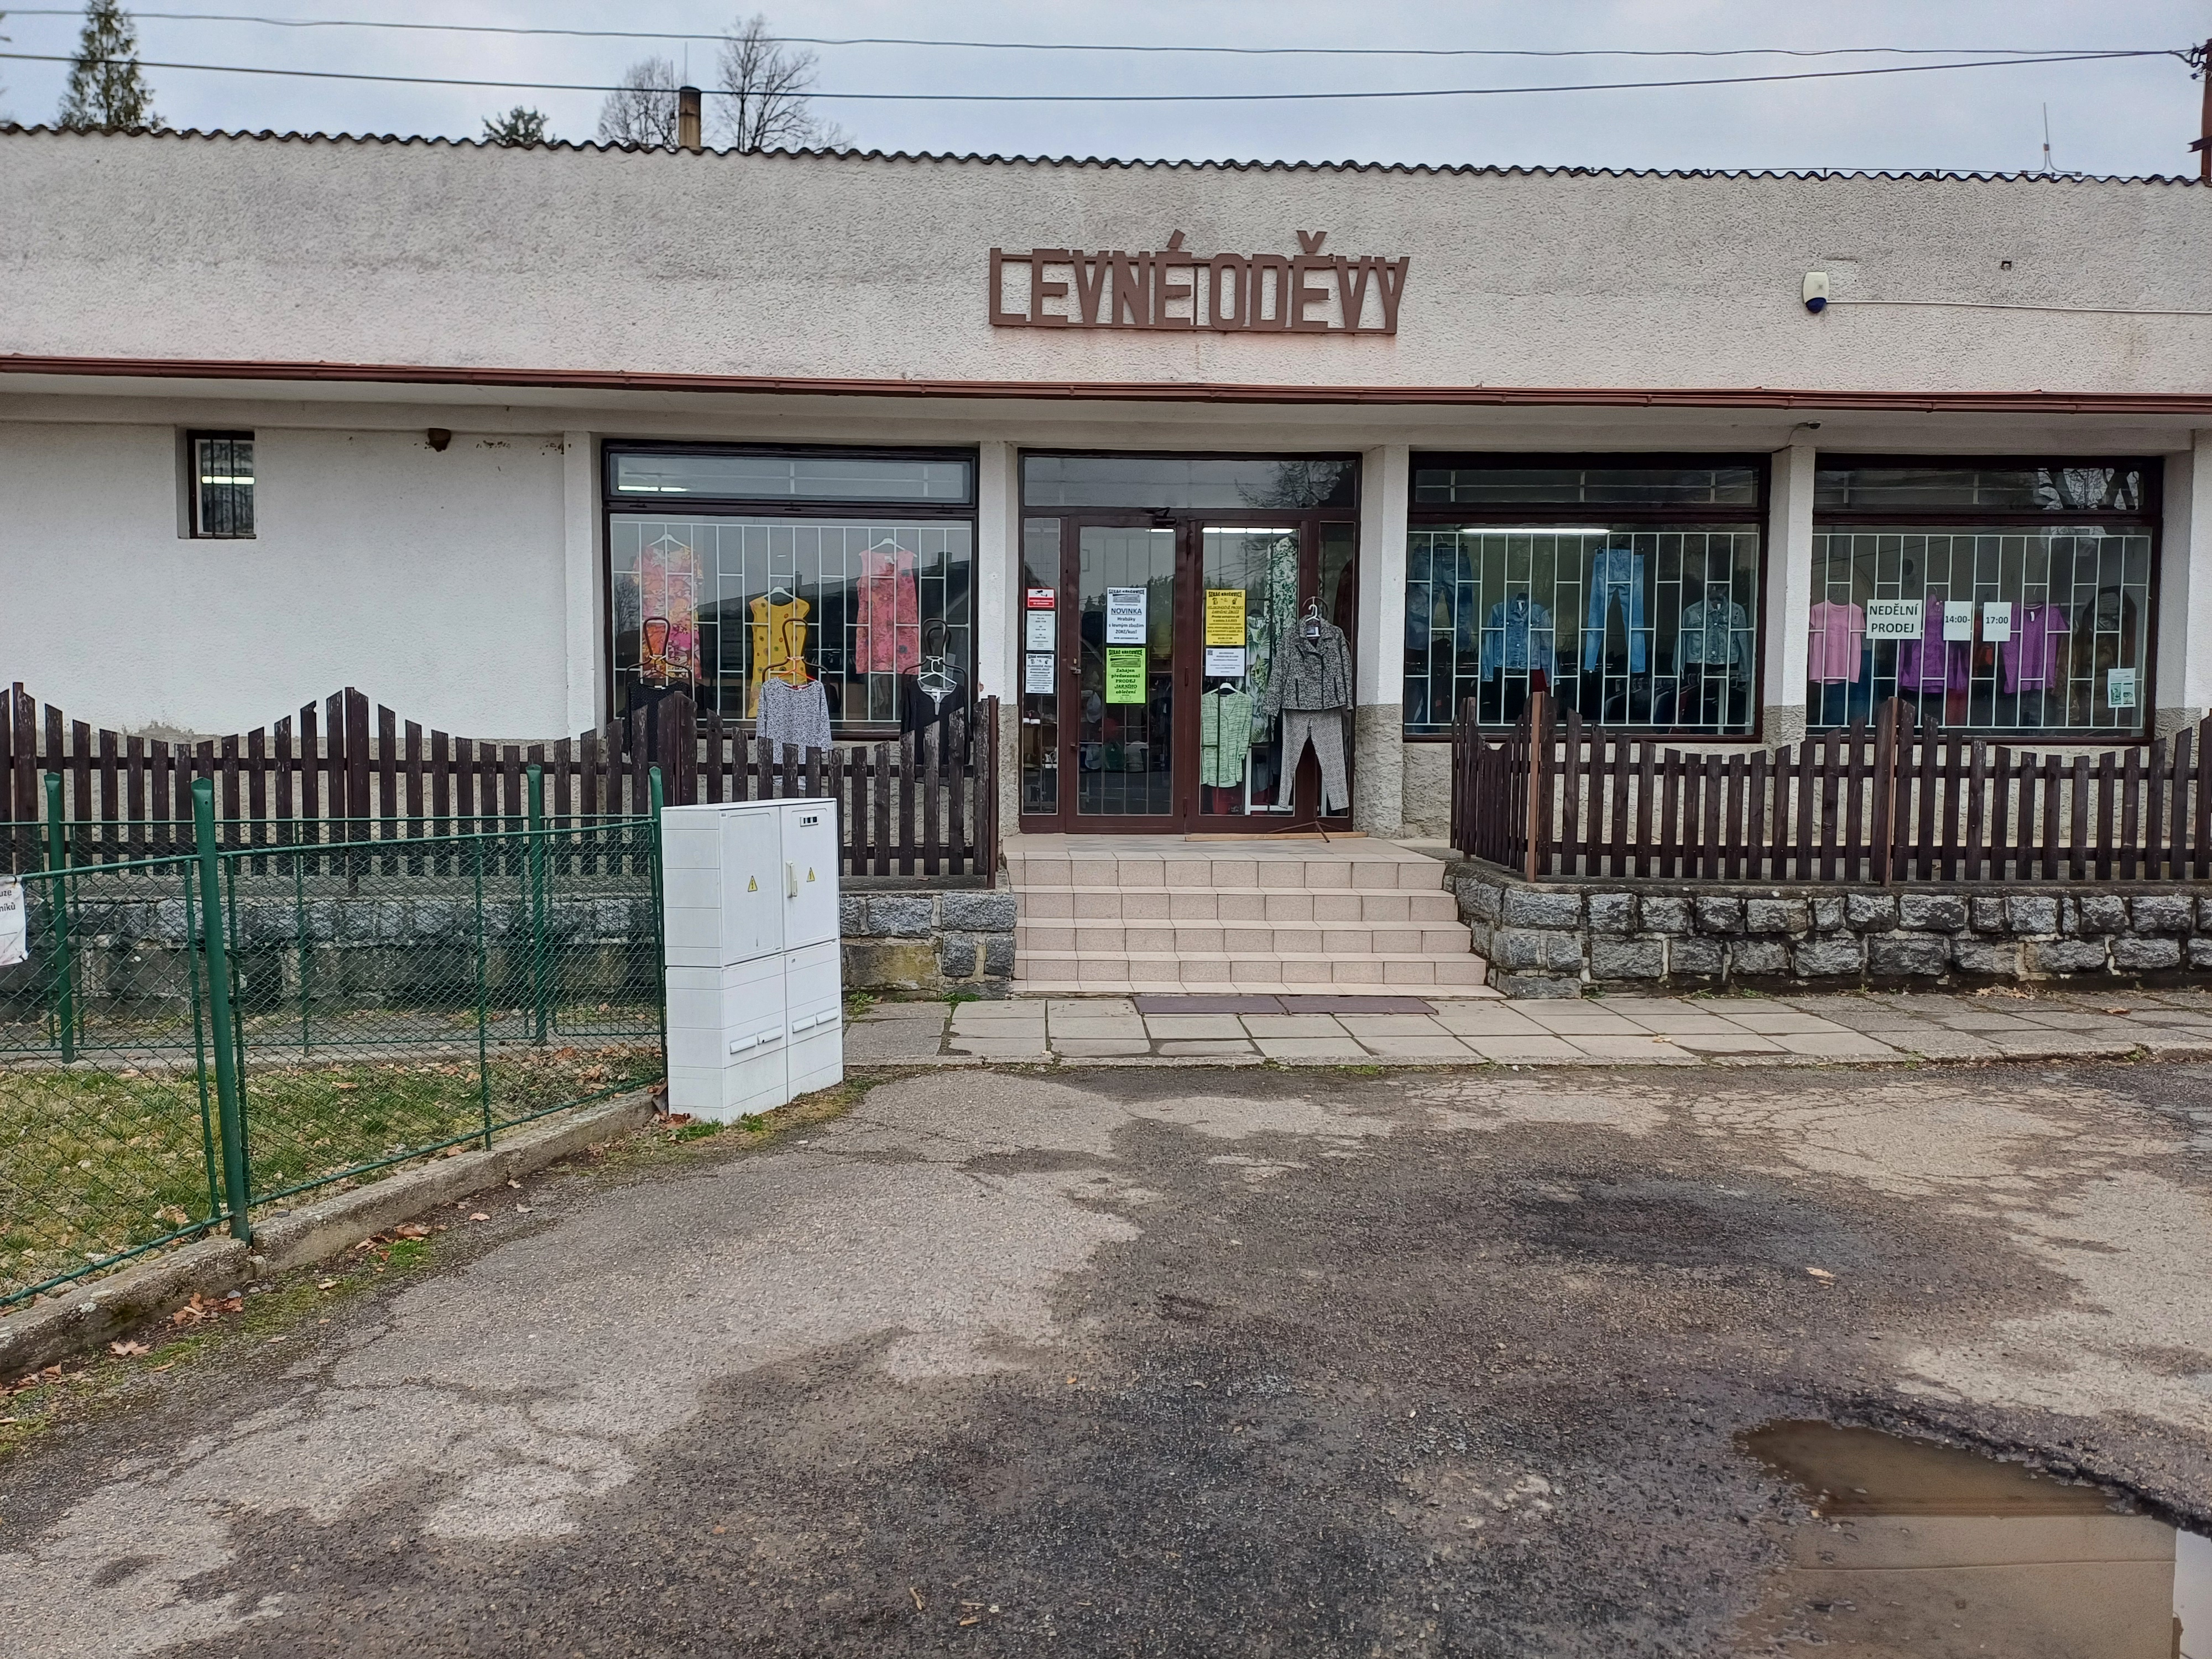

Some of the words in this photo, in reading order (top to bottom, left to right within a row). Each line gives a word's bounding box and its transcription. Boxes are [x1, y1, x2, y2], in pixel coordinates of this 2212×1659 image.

[990, 229, 1192, 327] LEVNÉ
[1209, 230, 1411, 334] ODĚVY
[1870, 603, 1919, 615] NEDĚLNÍ
[1871, 623, 1914, 633] PRODEJ
